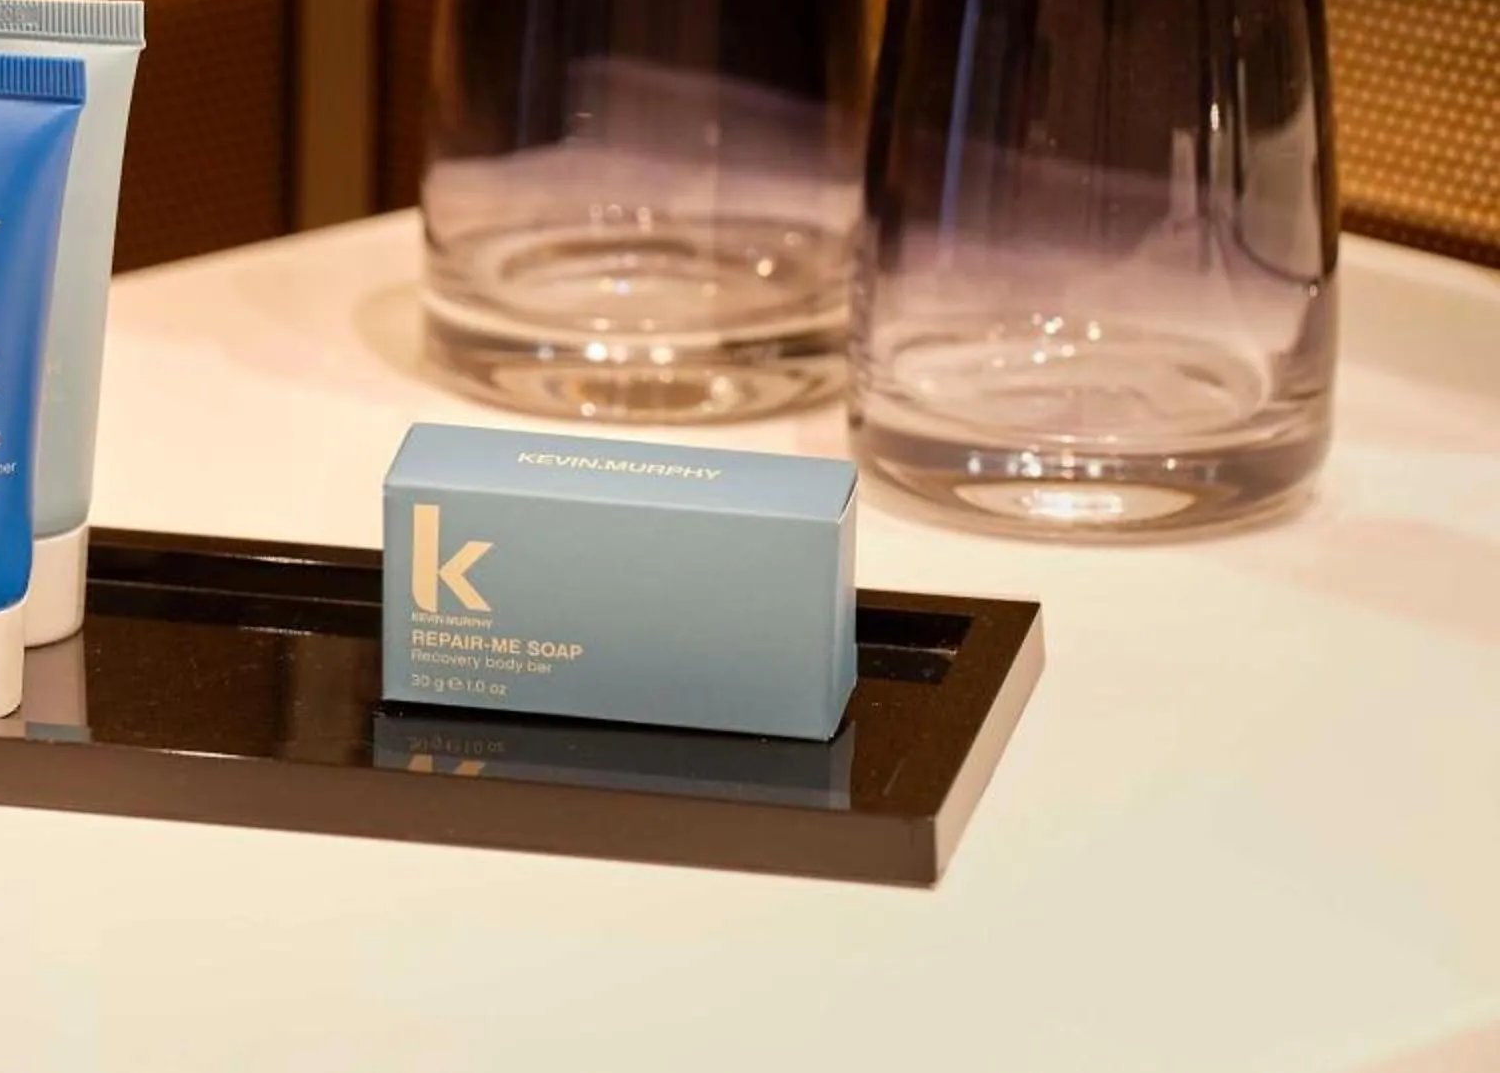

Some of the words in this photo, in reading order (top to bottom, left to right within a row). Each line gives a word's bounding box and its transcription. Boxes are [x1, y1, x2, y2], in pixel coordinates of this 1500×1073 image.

[517, 451, 722, 481] KEVIN.MURPHY
[412, 629, 522, 655] REPAIR-ME
[526, 640, 584, 661] SOAP
[411, 647, 481, 670] Recovery
[485, 655, 523, 674] body
[527, 661, 553, 674] bar
[411, 673, 430, 688] 30
[433, 677, 445, 693] g
[466, 676, 486, 693] 1.0
[489, 684, 508, 696] oz
